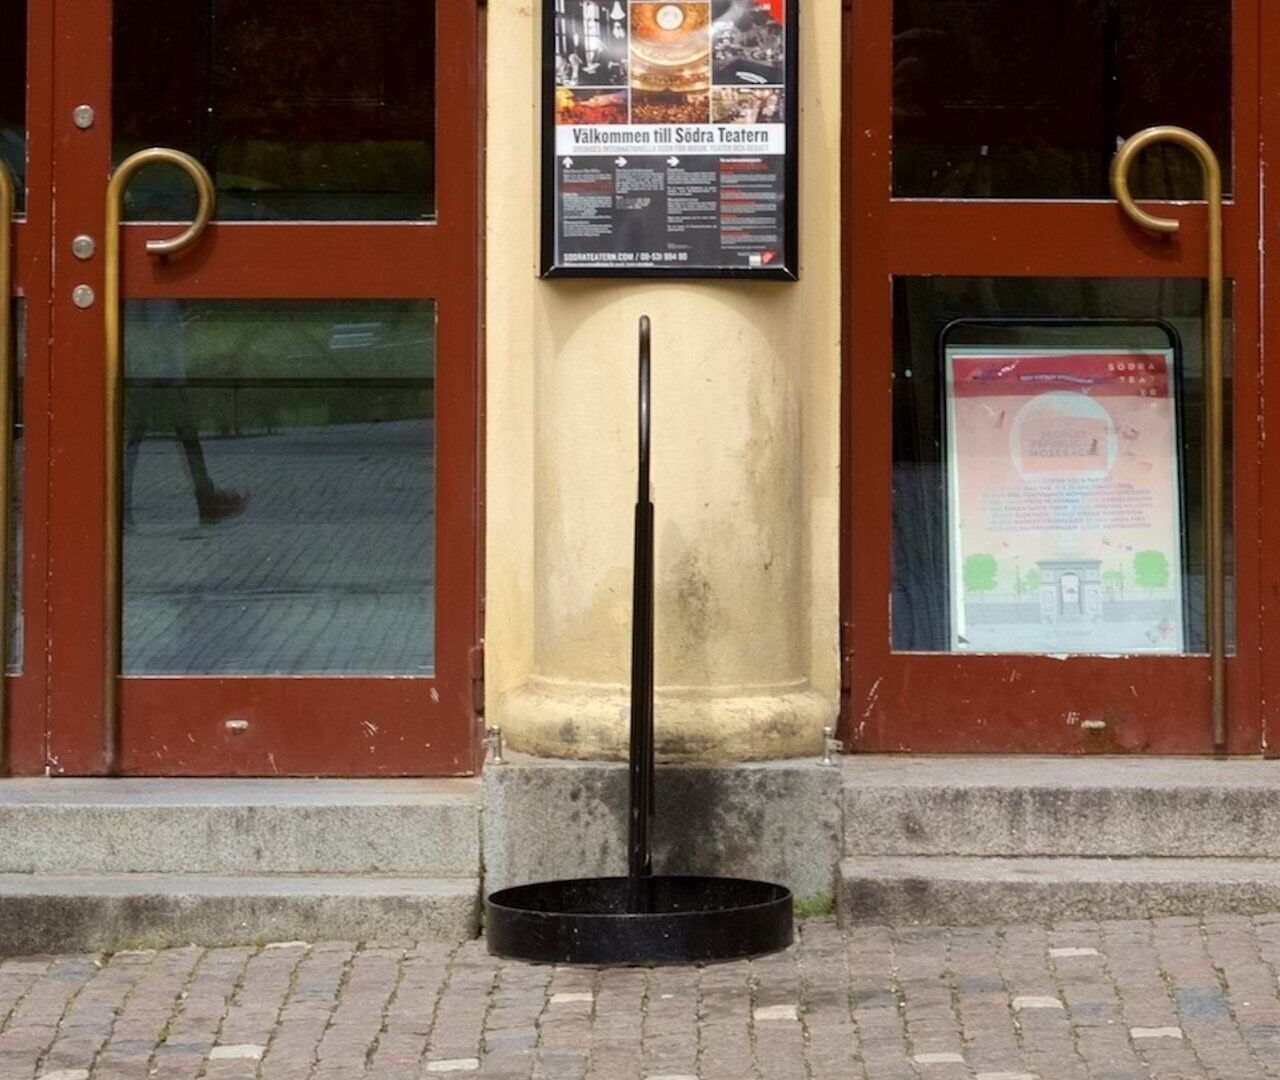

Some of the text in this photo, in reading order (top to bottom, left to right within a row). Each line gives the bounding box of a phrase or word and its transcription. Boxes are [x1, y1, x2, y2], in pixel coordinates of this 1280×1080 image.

[572, 127, 769, 144] Välkommen till Södra Teatern
